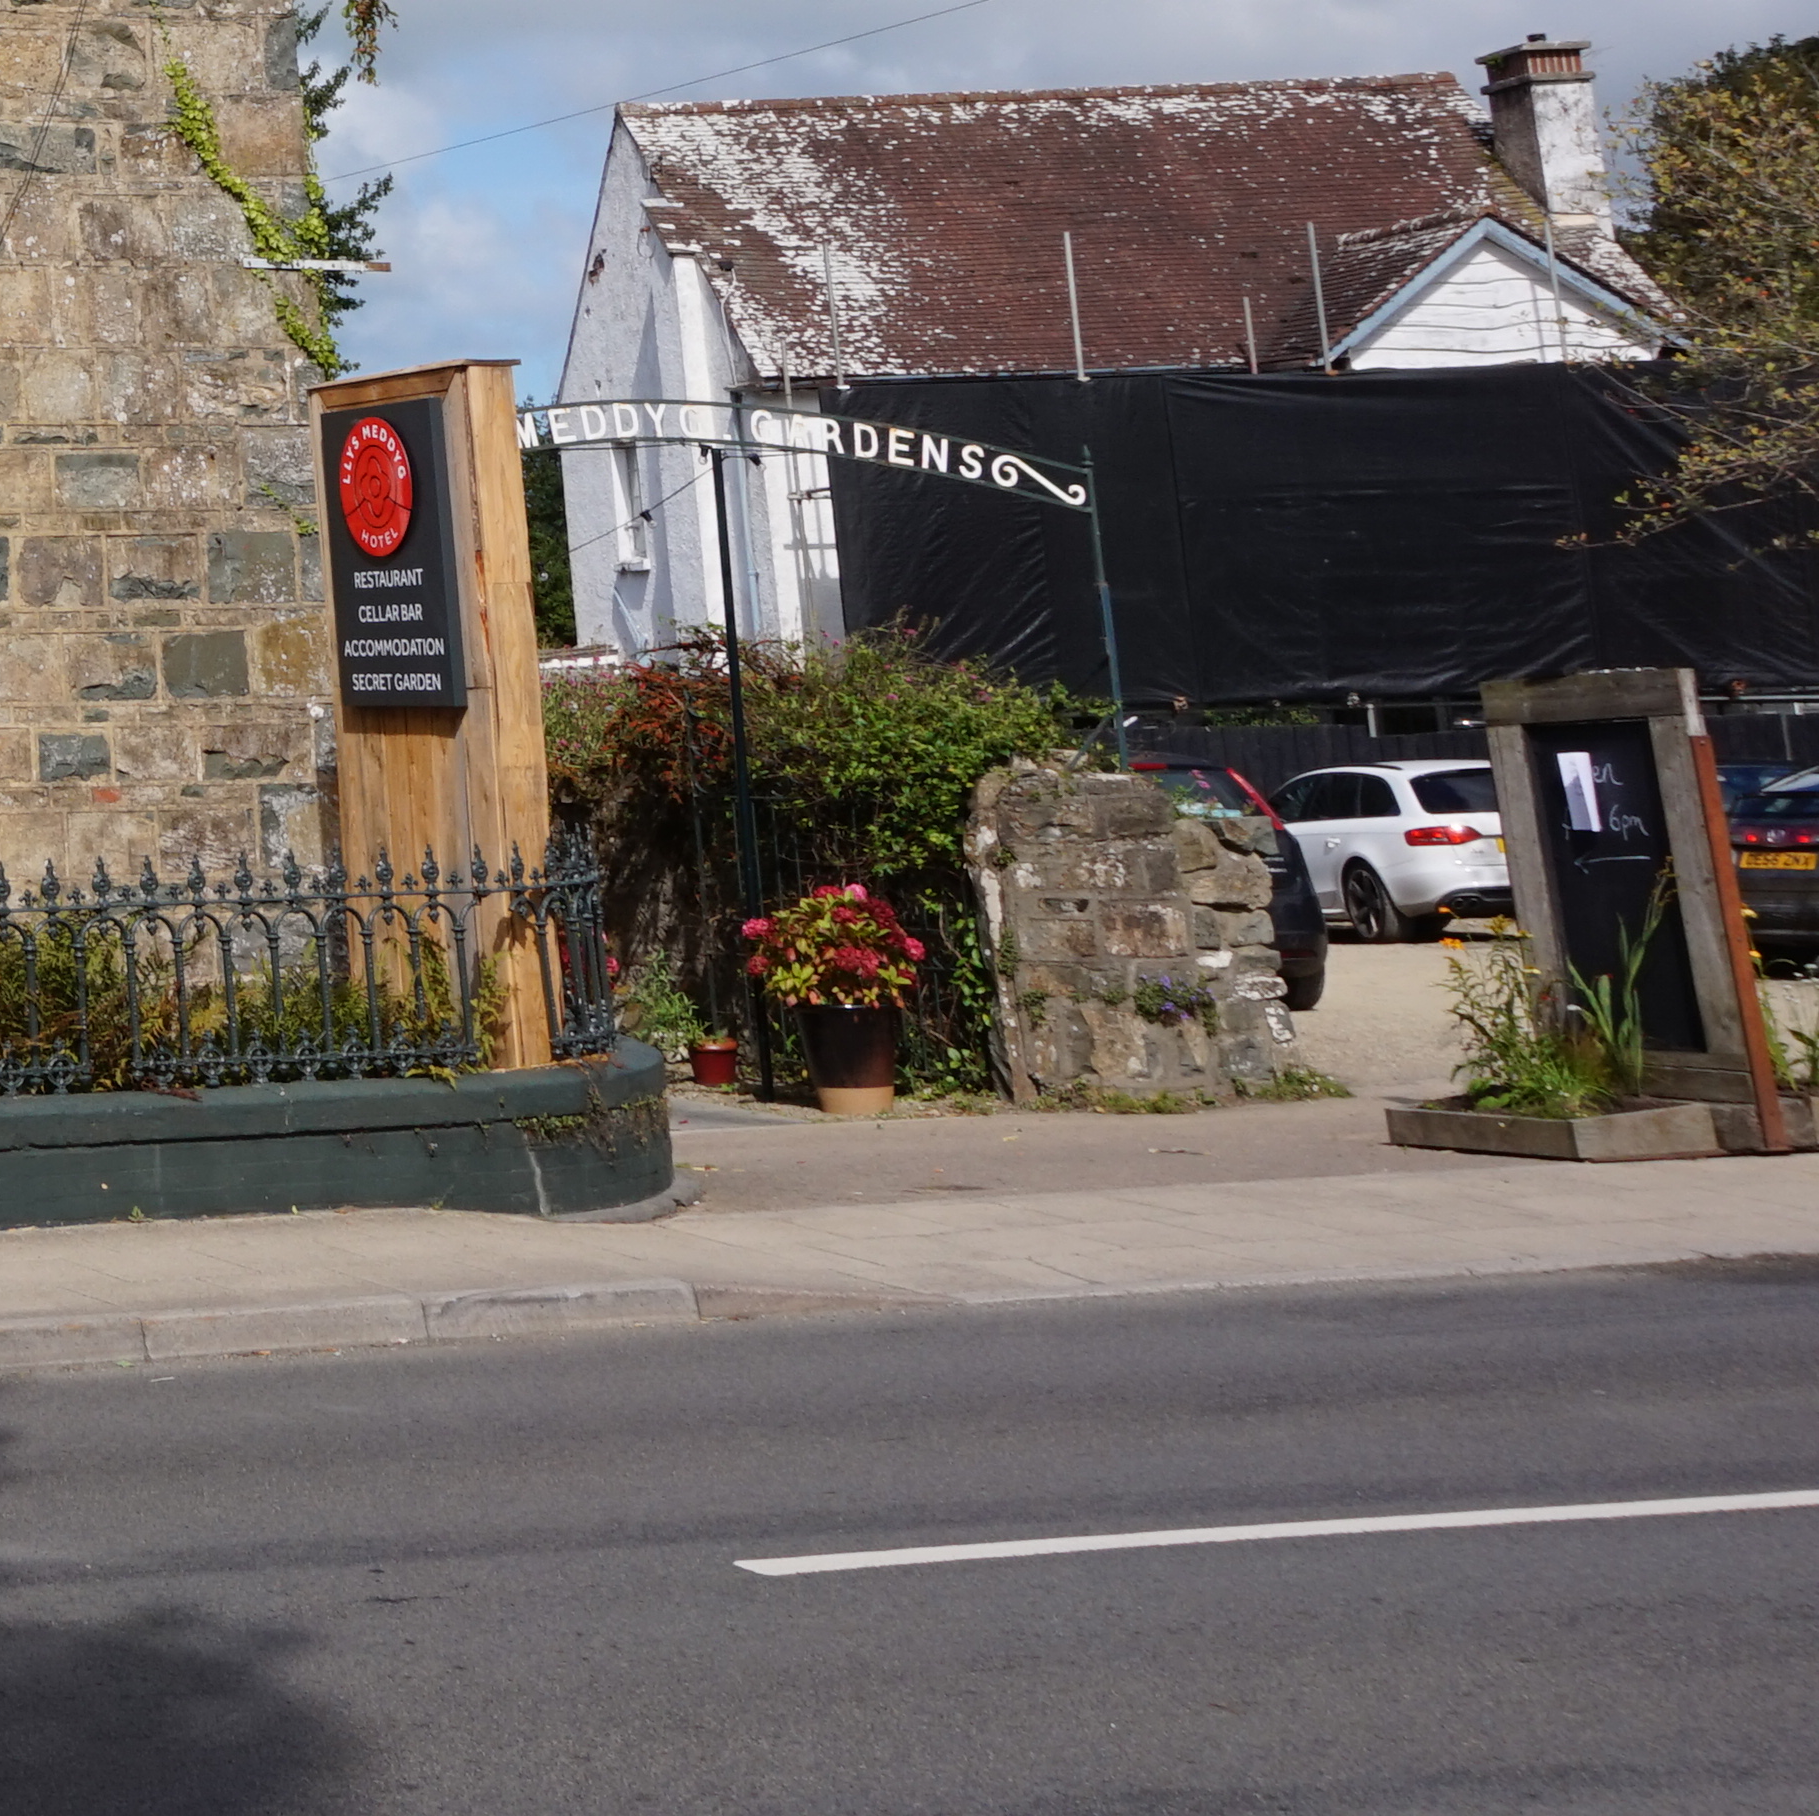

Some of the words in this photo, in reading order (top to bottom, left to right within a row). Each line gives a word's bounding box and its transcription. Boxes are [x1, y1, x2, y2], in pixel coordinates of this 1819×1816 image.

[342, 435, 360, 485] LLYS
[361, 424, 407, 480] MEDDYG
[750, 409, 985, 479] GARDENS
[361, 527, 399, 549] HOTEL
[353, 568, 424, 590] RESTAURANT
[358, 604, 400, 624] CELLAR
[400, 603, 424, 622] BAR
[344, 637, 445, 657] ACCOMMODATION
[351, 673, 393, 692] SECRET
[394, 672, 442, 692] GARDEN
[1608, 804, 1650, 842] 6pm
